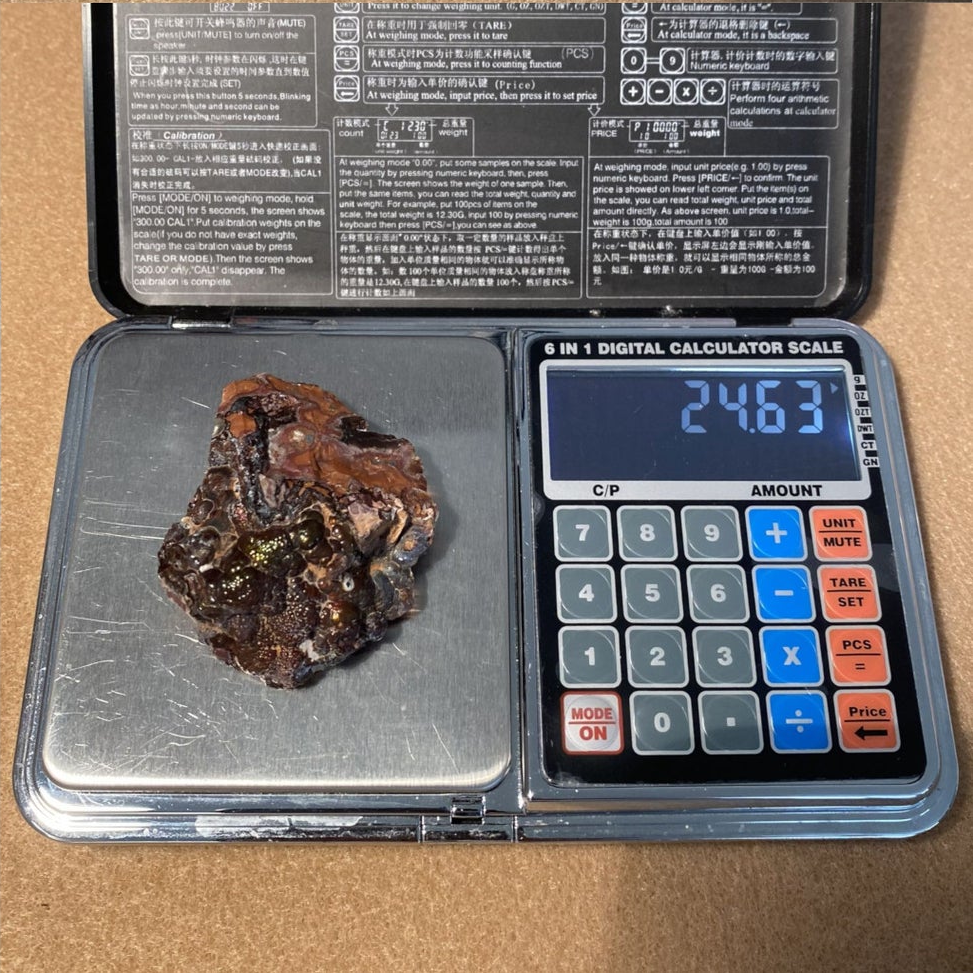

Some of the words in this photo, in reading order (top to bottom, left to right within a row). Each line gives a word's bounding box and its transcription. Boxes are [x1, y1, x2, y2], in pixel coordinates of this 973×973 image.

[366, 31, 376, 39] At
[379, 31, 418, 42] weighing
[421, 31, 446, 40] mode,
[449, 33, 471, 41] press
[492, 32, 508, 40] tare
[657, 31, 668, 39] At
[671, 30, 712, 39] calculator
[714, 31, 740, 40] mode,
[768, 31, 810, 41] backspace
[371, 59, 381, 67] At
[383, 59, 421, 70] weighing
[424, 60, 448, 69] mode,
[450, 61, 471, 70] press
[474, 60, 480, 68] it
[482, 60, 490, 68] to
[492, 60, 527, 70] counting
[529, 60, 562, 68] function
[690, 62, 727, 70] Numeric
[729, 62, 770, 72] keyboard
[367, 91, 378, 99] At
[380, 91, 419, 101] weighing
[421, 91, 447, 100] mode,
[450, 92, 472, 102] input
[474, 92, 497, 101] price,
[500, 91, 518, 100] then
[520, 93, 542, 102] press
[544, 91, 551, 100] it
[552, 92, 561, 100] to
[563, 92, 575, 100] set
[576, 92, 598, 102] price
[730, 94, 765, 103] Perform
[768, 94, 786, 103] four
[788, 94, 829, 103] arithmetic
[730, 107, 781, 115] calculations
[784, 107, 793, 115] at
[795, 107, 836, 115] calculator
[730, 118, 753, 127] mode
[163, 131, 216, 140] Calibration
[339, 129, 364, 137] count
[438, 129, 468, 137] weight
[591, 130, 617, 138] PRICE
[690, 129, 720, 138] weight
[134, 254, 160, 262] TARE
[162, 254, 177, 262] OR
[239, 255, 252, 263] the
[544, 342, 555, 355] 6
[560, 342, 578, 355] IN
[583, 342, 592, 355] 1
[598, 342, 665, 355] DIGITAL
[670, 341, 783, 355] CALCULATOR
[788, 341, 844, 354] SCALE
[681, 380, 823, 434] 24.63
[861, 441, 874, 449] CT
[592, 484, 620, 498] C/P
[751, 485, 823, 497] AMOUNT
[822, 518, 856, 529] UNIT
[576, 525, 590, 542] 7
[639, 524, 655, 542] 8
[704, 524, 720, 542] 9
[823, 537, 862, 547] MUTE
[830, 577, 866, 588] TARE
[578, 584, 594, 602] 4
[645, 584, 660, 602] 5
[710, 584, 726, 602] 6
[838, 597, 864, 607] SET
[842, 639, 872, 650] PCS
[585, 647, 596, 666] 1
[650, 647, 666, 666] 2
[717, 647, 733, 666] 3
[571, 708, 613, 720] MODE
[849, 706, 887, 717] Price
[654, 713, 670, 733] 0
[579, 726, 607, 741] ON
